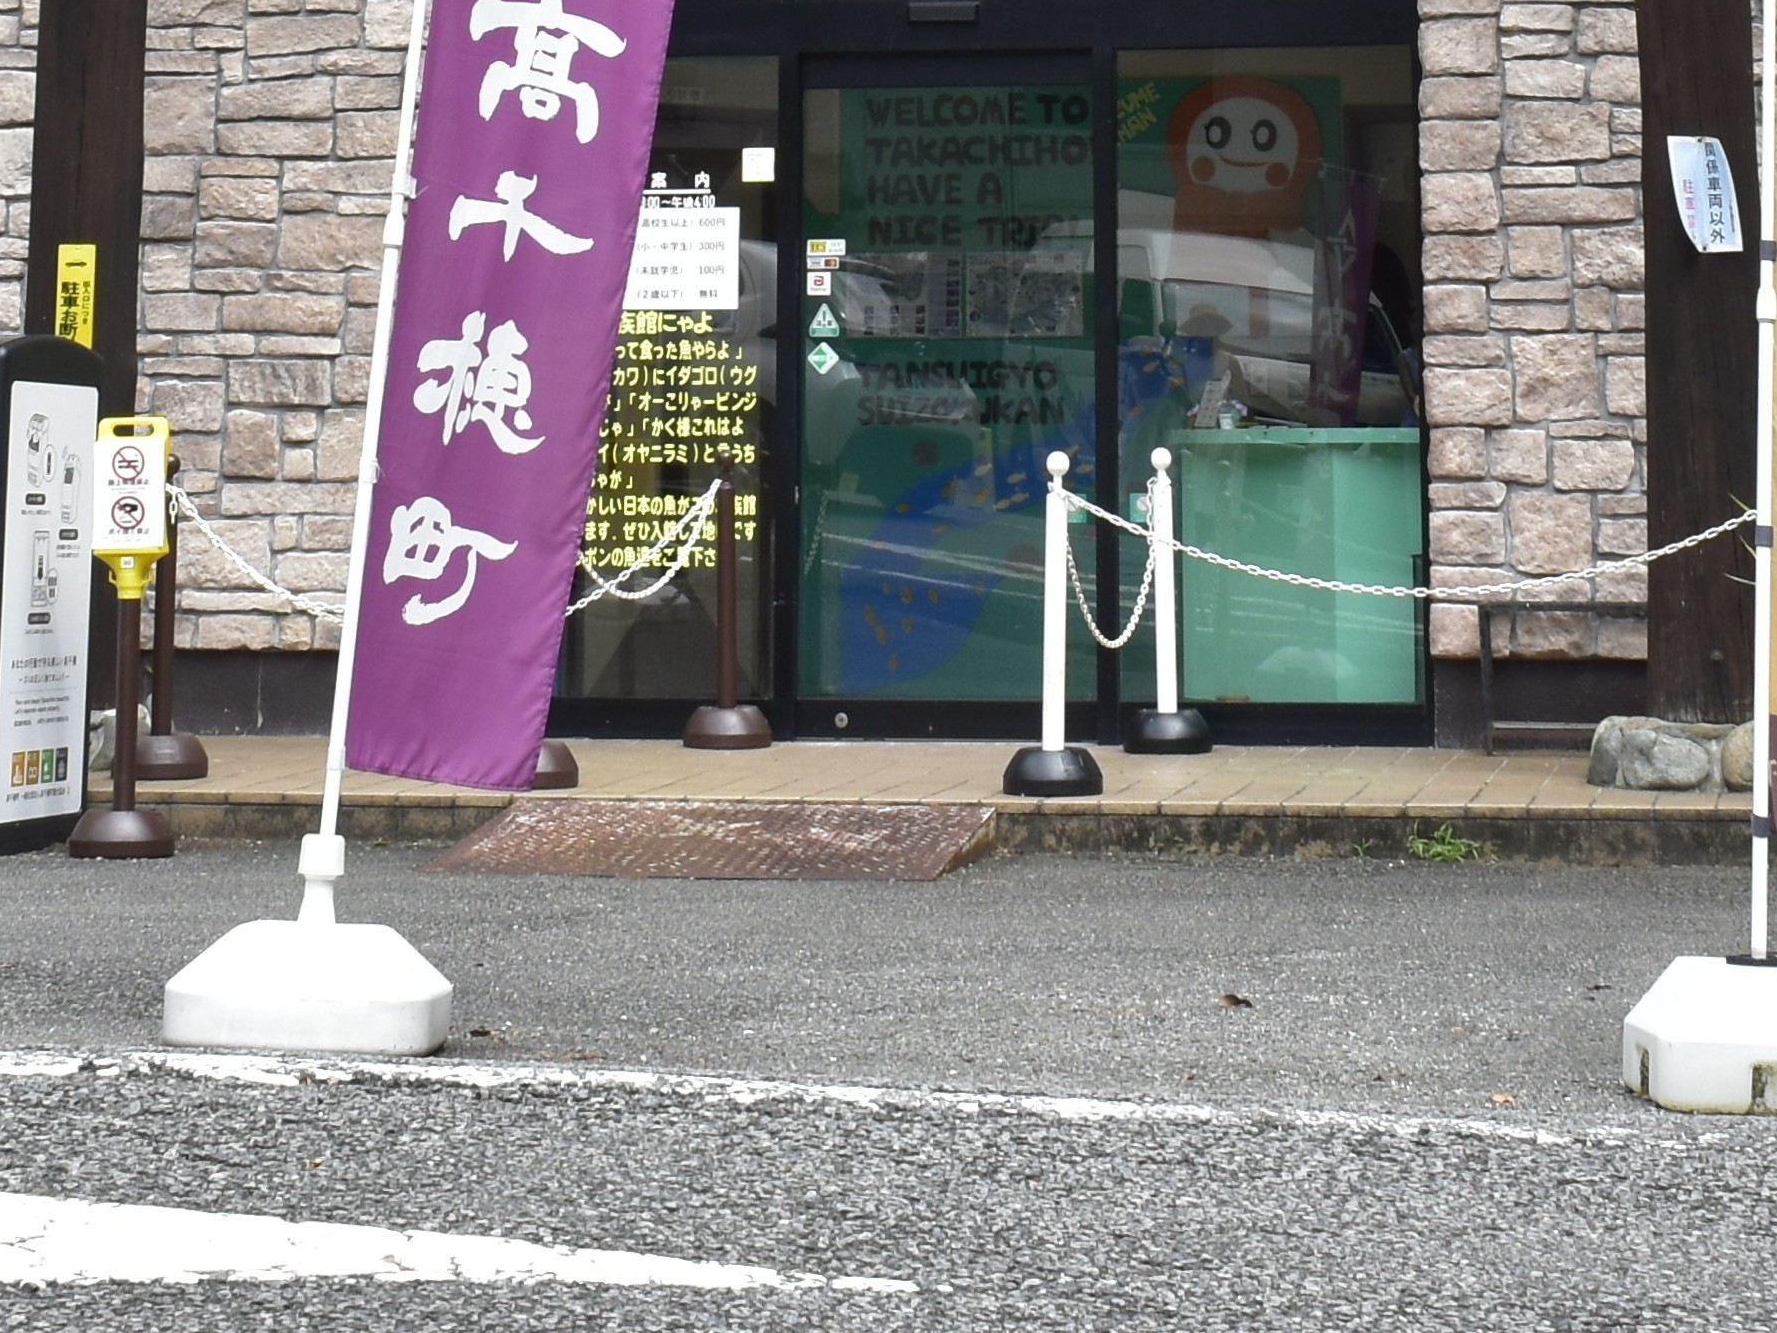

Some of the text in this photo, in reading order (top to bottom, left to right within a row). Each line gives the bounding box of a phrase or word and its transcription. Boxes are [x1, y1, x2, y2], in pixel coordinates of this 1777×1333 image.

[865, 93, 1089, 126] WELCOME TO
[865, 134, 1089, 167] TAKACHIHO
[868, 172, 1002, 205] HAVE A
[1704, 142, 1725, 243] 関係車両以外
[699, 218, 725, 227] 600円
[868, 215, 961, 246] NICE
[699, 242, 725, 251] 300円
[699, 266, 725, 275] 100円
